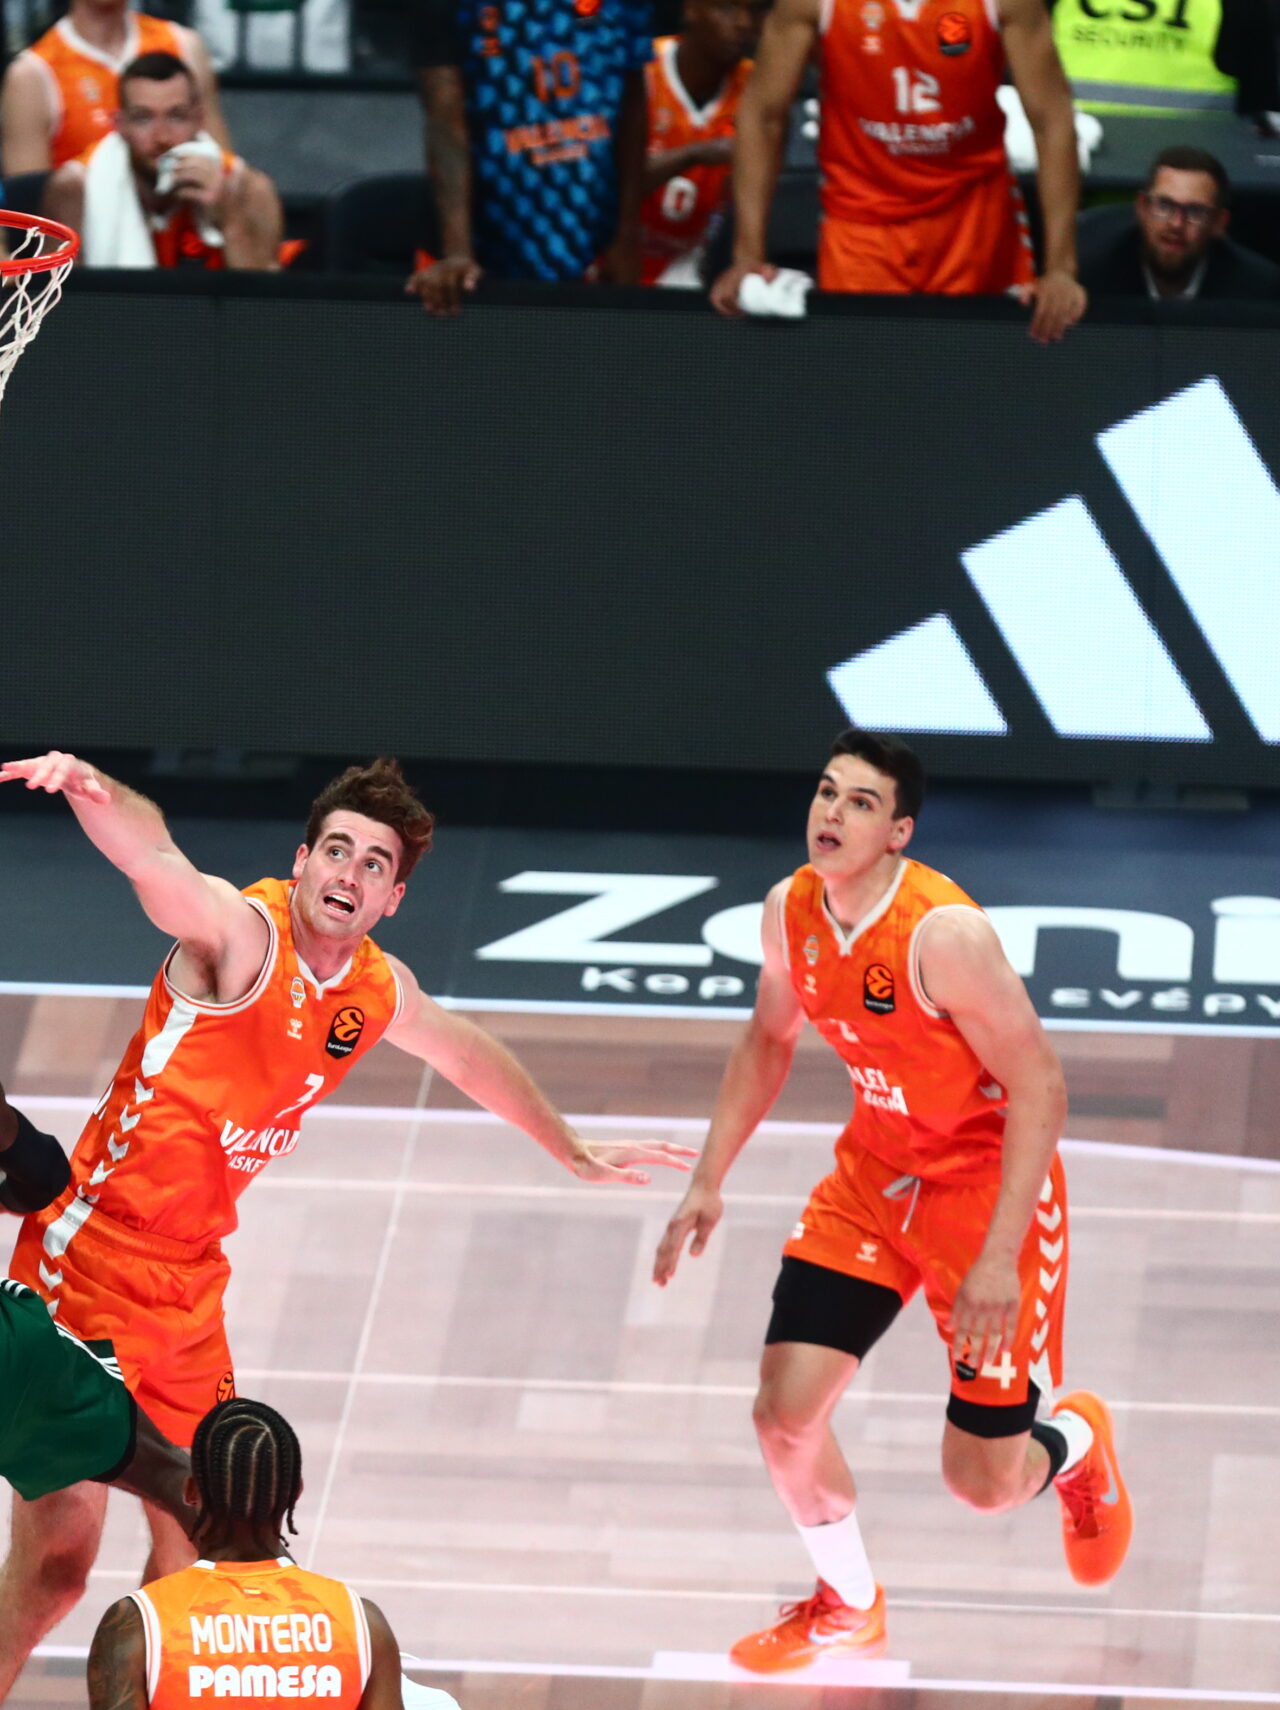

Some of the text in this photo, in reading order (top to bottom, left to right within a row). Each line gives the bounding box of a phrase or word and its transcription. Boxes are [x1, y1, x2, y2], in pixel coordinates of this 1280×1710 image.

[532, 50, 581, 102] 10
[892, 66, 942, 114] 12
[662, 176, 697, 221] 0
[275, 1073, 324, 1118] 7
[190, 1613, 333, 1655] MONTERO
[188, 1664, 342, 1698] PAMESA
